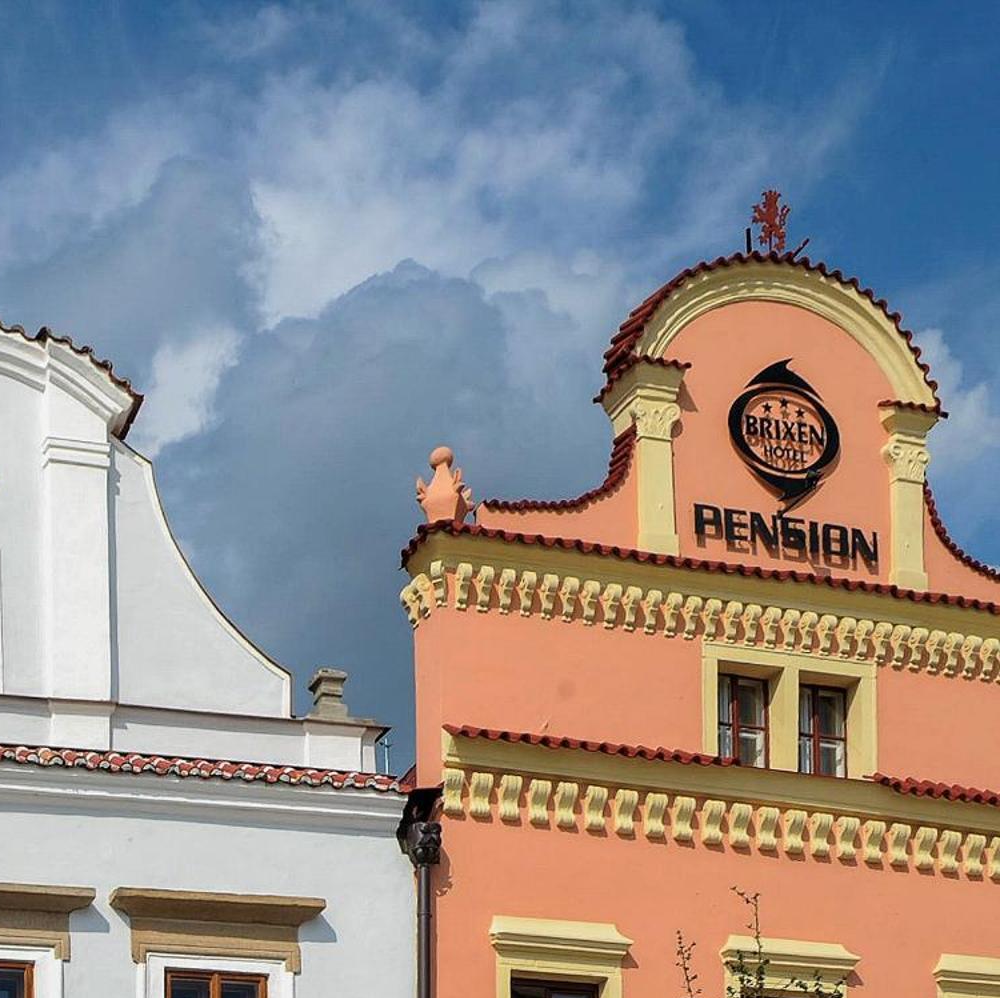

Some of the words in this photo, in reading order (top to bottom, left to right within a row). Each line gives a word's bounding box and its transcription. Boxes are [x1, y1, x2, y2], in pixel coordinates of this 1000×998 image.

[745, 414, 826, 446] BRIXEN
[763, 446, 808, 464] HOTEL
[694, 502, 879, 564] PENSION
